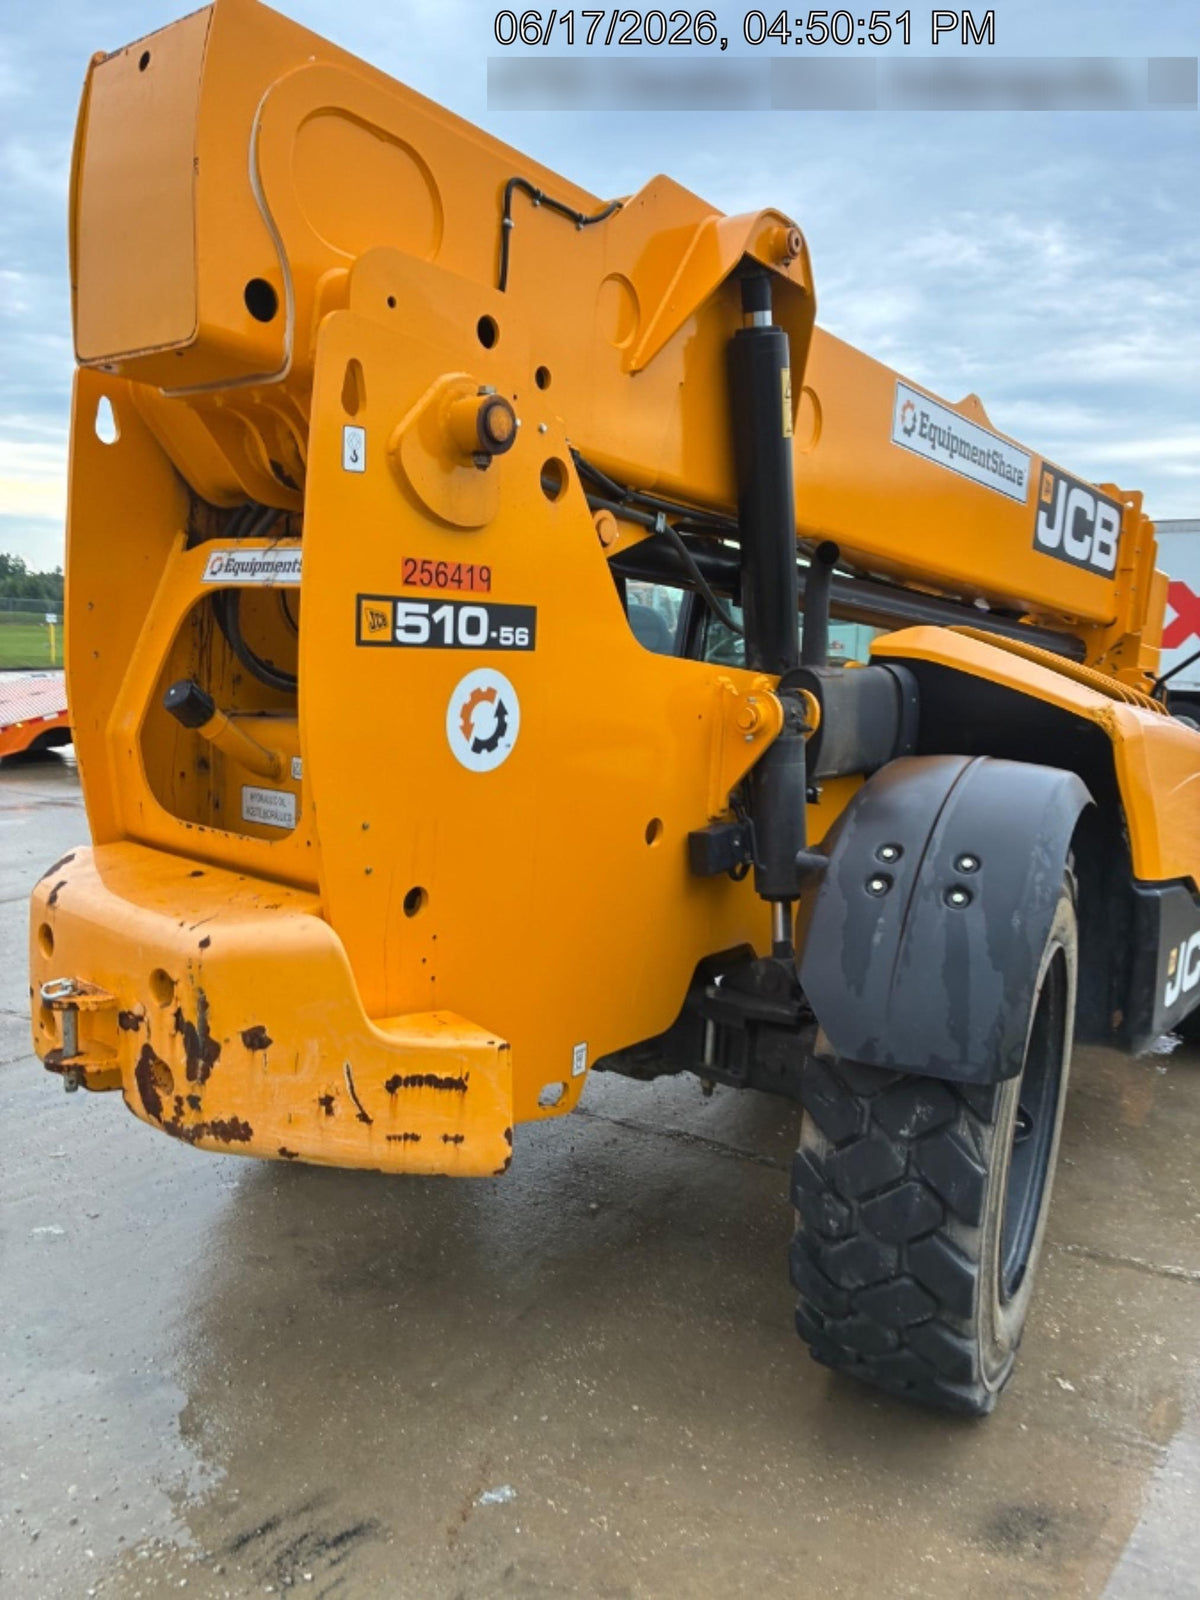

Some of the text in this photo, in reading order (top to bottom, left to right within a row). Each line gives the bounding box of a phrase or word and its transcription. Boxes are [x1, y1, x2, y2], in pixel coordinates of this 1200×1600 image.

[918, 410, 1024, 487] EquipmentShare
[1037, 479, 1121, 572] JCB
[403, 557, 492, 592] 256419
